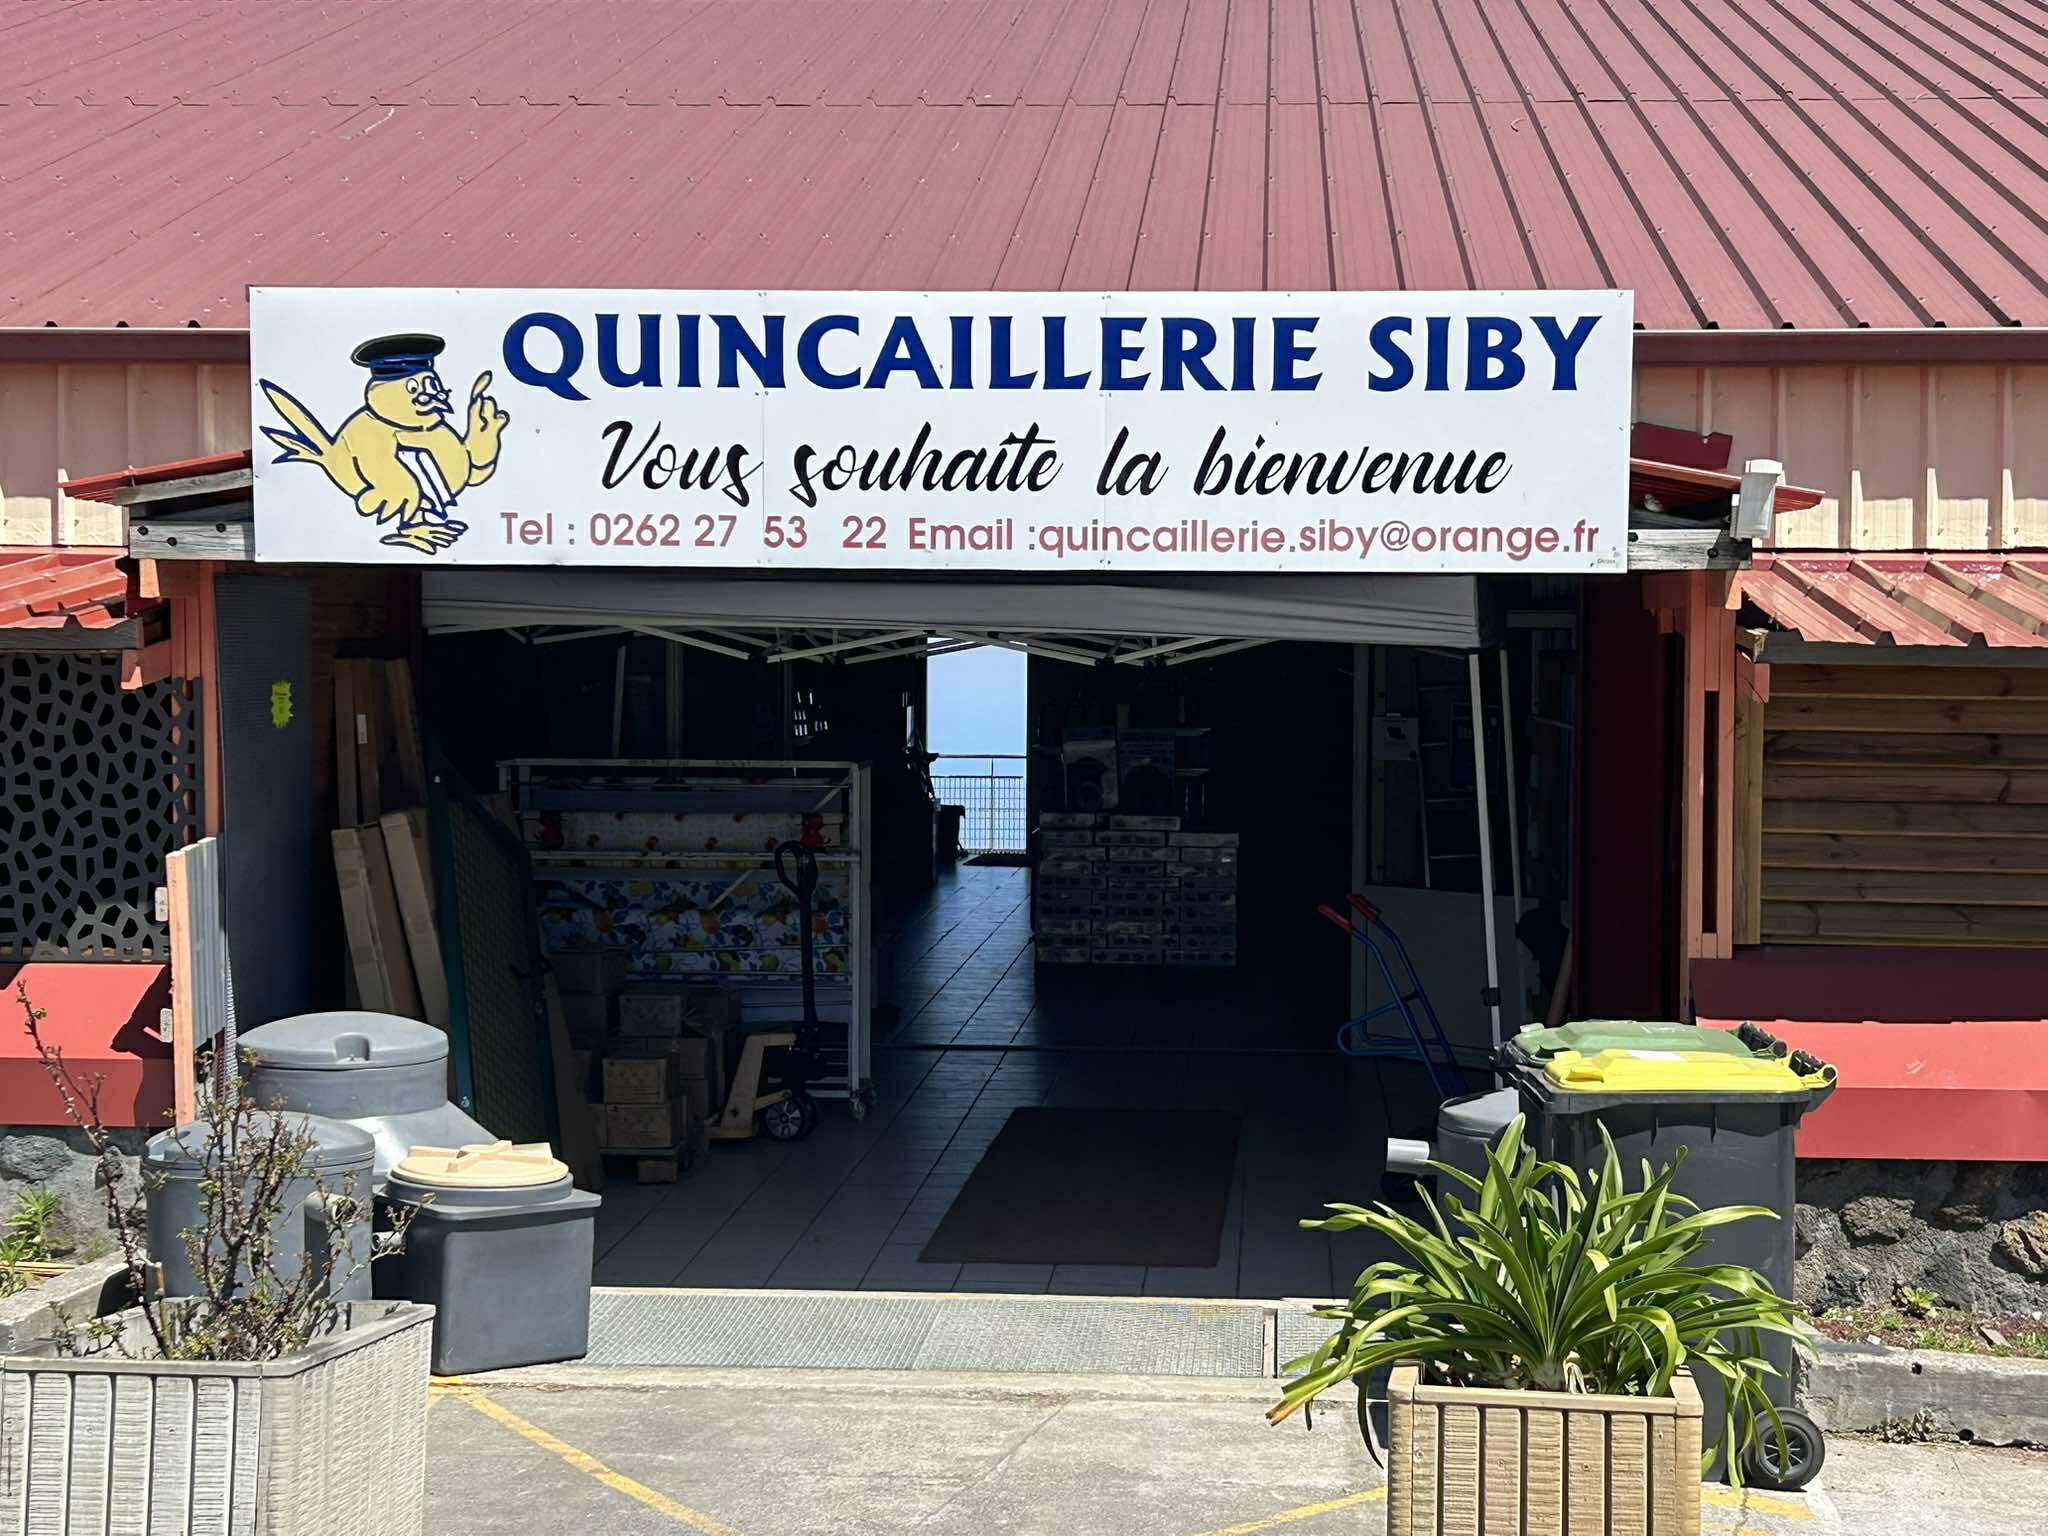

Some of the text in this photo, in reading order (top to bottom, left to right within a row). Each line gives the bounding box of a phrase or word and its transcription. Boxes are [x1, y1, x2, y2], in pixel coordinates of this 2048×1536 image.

[503, 311, 1604, 402] QUINCAILLERIE SIBY
[601, 420, 764, 508] Vous
[1096, 425, 1169, 497] la
[1193, 425, 1513, 496] bienvenue
[589, 512, 681, 547] 0262
[694, 513, 737, 548] 27
[763, 515, 808, 549] 53
[842, 515, 887, 550] 22
[908, 517, 1013, 551] Email
